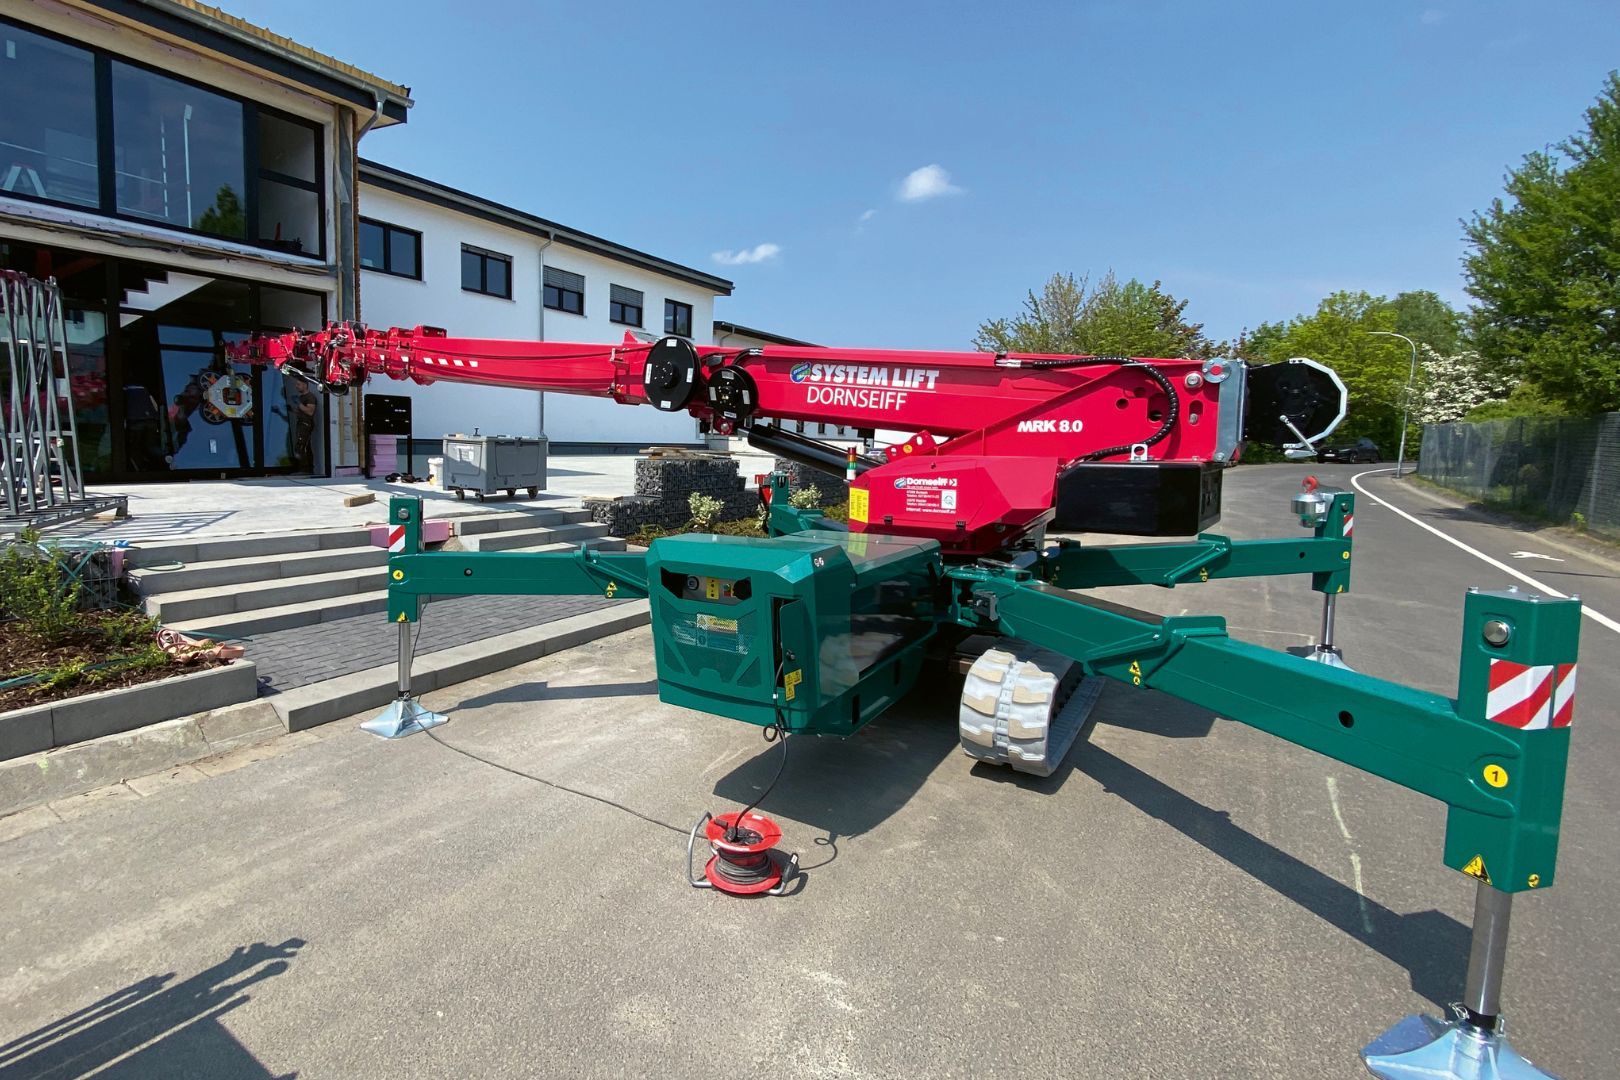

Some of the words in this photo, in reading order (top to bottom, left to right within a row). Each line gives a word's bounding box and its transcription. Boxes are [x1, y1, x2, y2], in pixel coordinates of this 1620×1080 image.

[810, 363, 888, 386] SYSTEM
[891, 368, 940, 389] LIFT
[806, 386, 908, 411] DORNSEIFF
[1016, 419, 1057, 433] MRK
[1059, 419, 1084, 433] 8.0
[906, 476, 948, 486] Dornseiff
